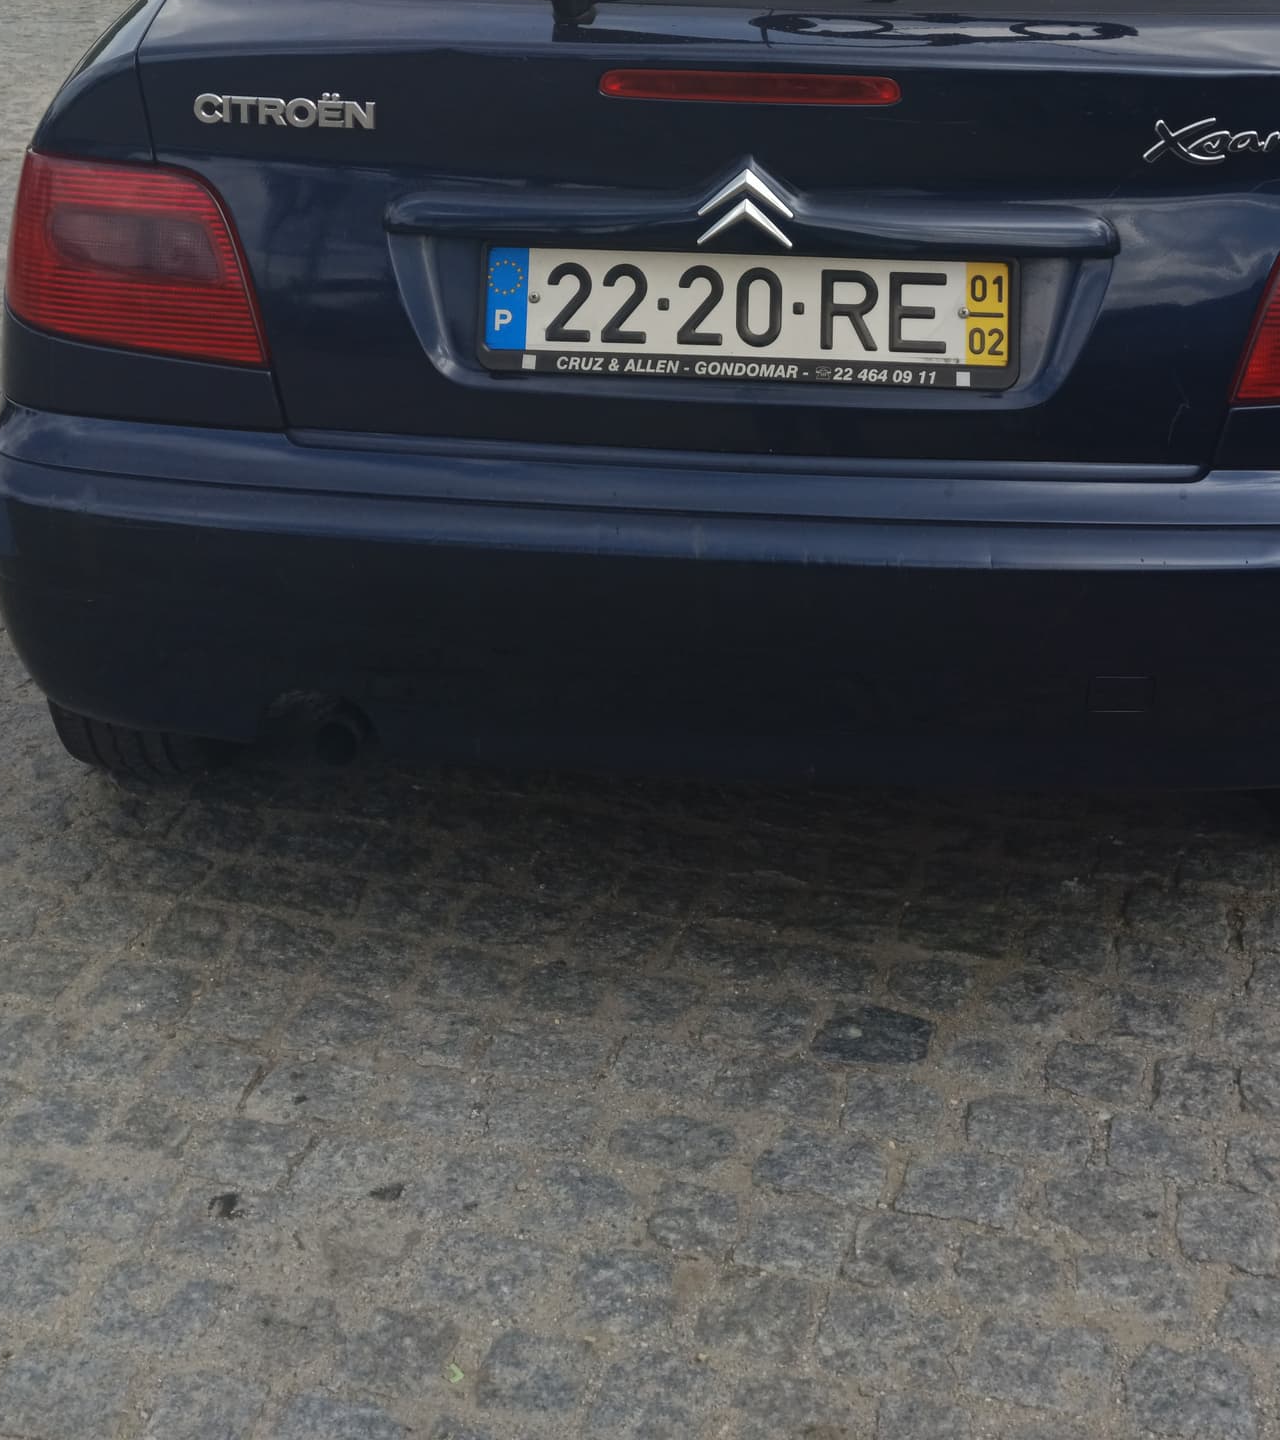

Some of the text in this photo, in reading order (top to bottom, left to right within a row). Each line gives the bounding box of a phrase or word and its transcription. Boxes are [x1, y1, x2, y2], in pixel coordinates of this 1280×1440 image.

[193, 92, 376, 129] CITROËN
[970, 275, 1004, 303] 01
[494, 309, 513, 331] P
[969, 327, 1004, 356] 02
[556, 357, 604, 371] CRUZ
[608, 358, 619, 371] &
[624, 359, 680, 374] ALLEN
[694, 361, 799, 379] GONDOMAR
[833, 367, 853, 381] 22
[857, 368, 888, 383] 464
[892, 370, 913, 383] 09
[919, 371, 936, 384] 11
